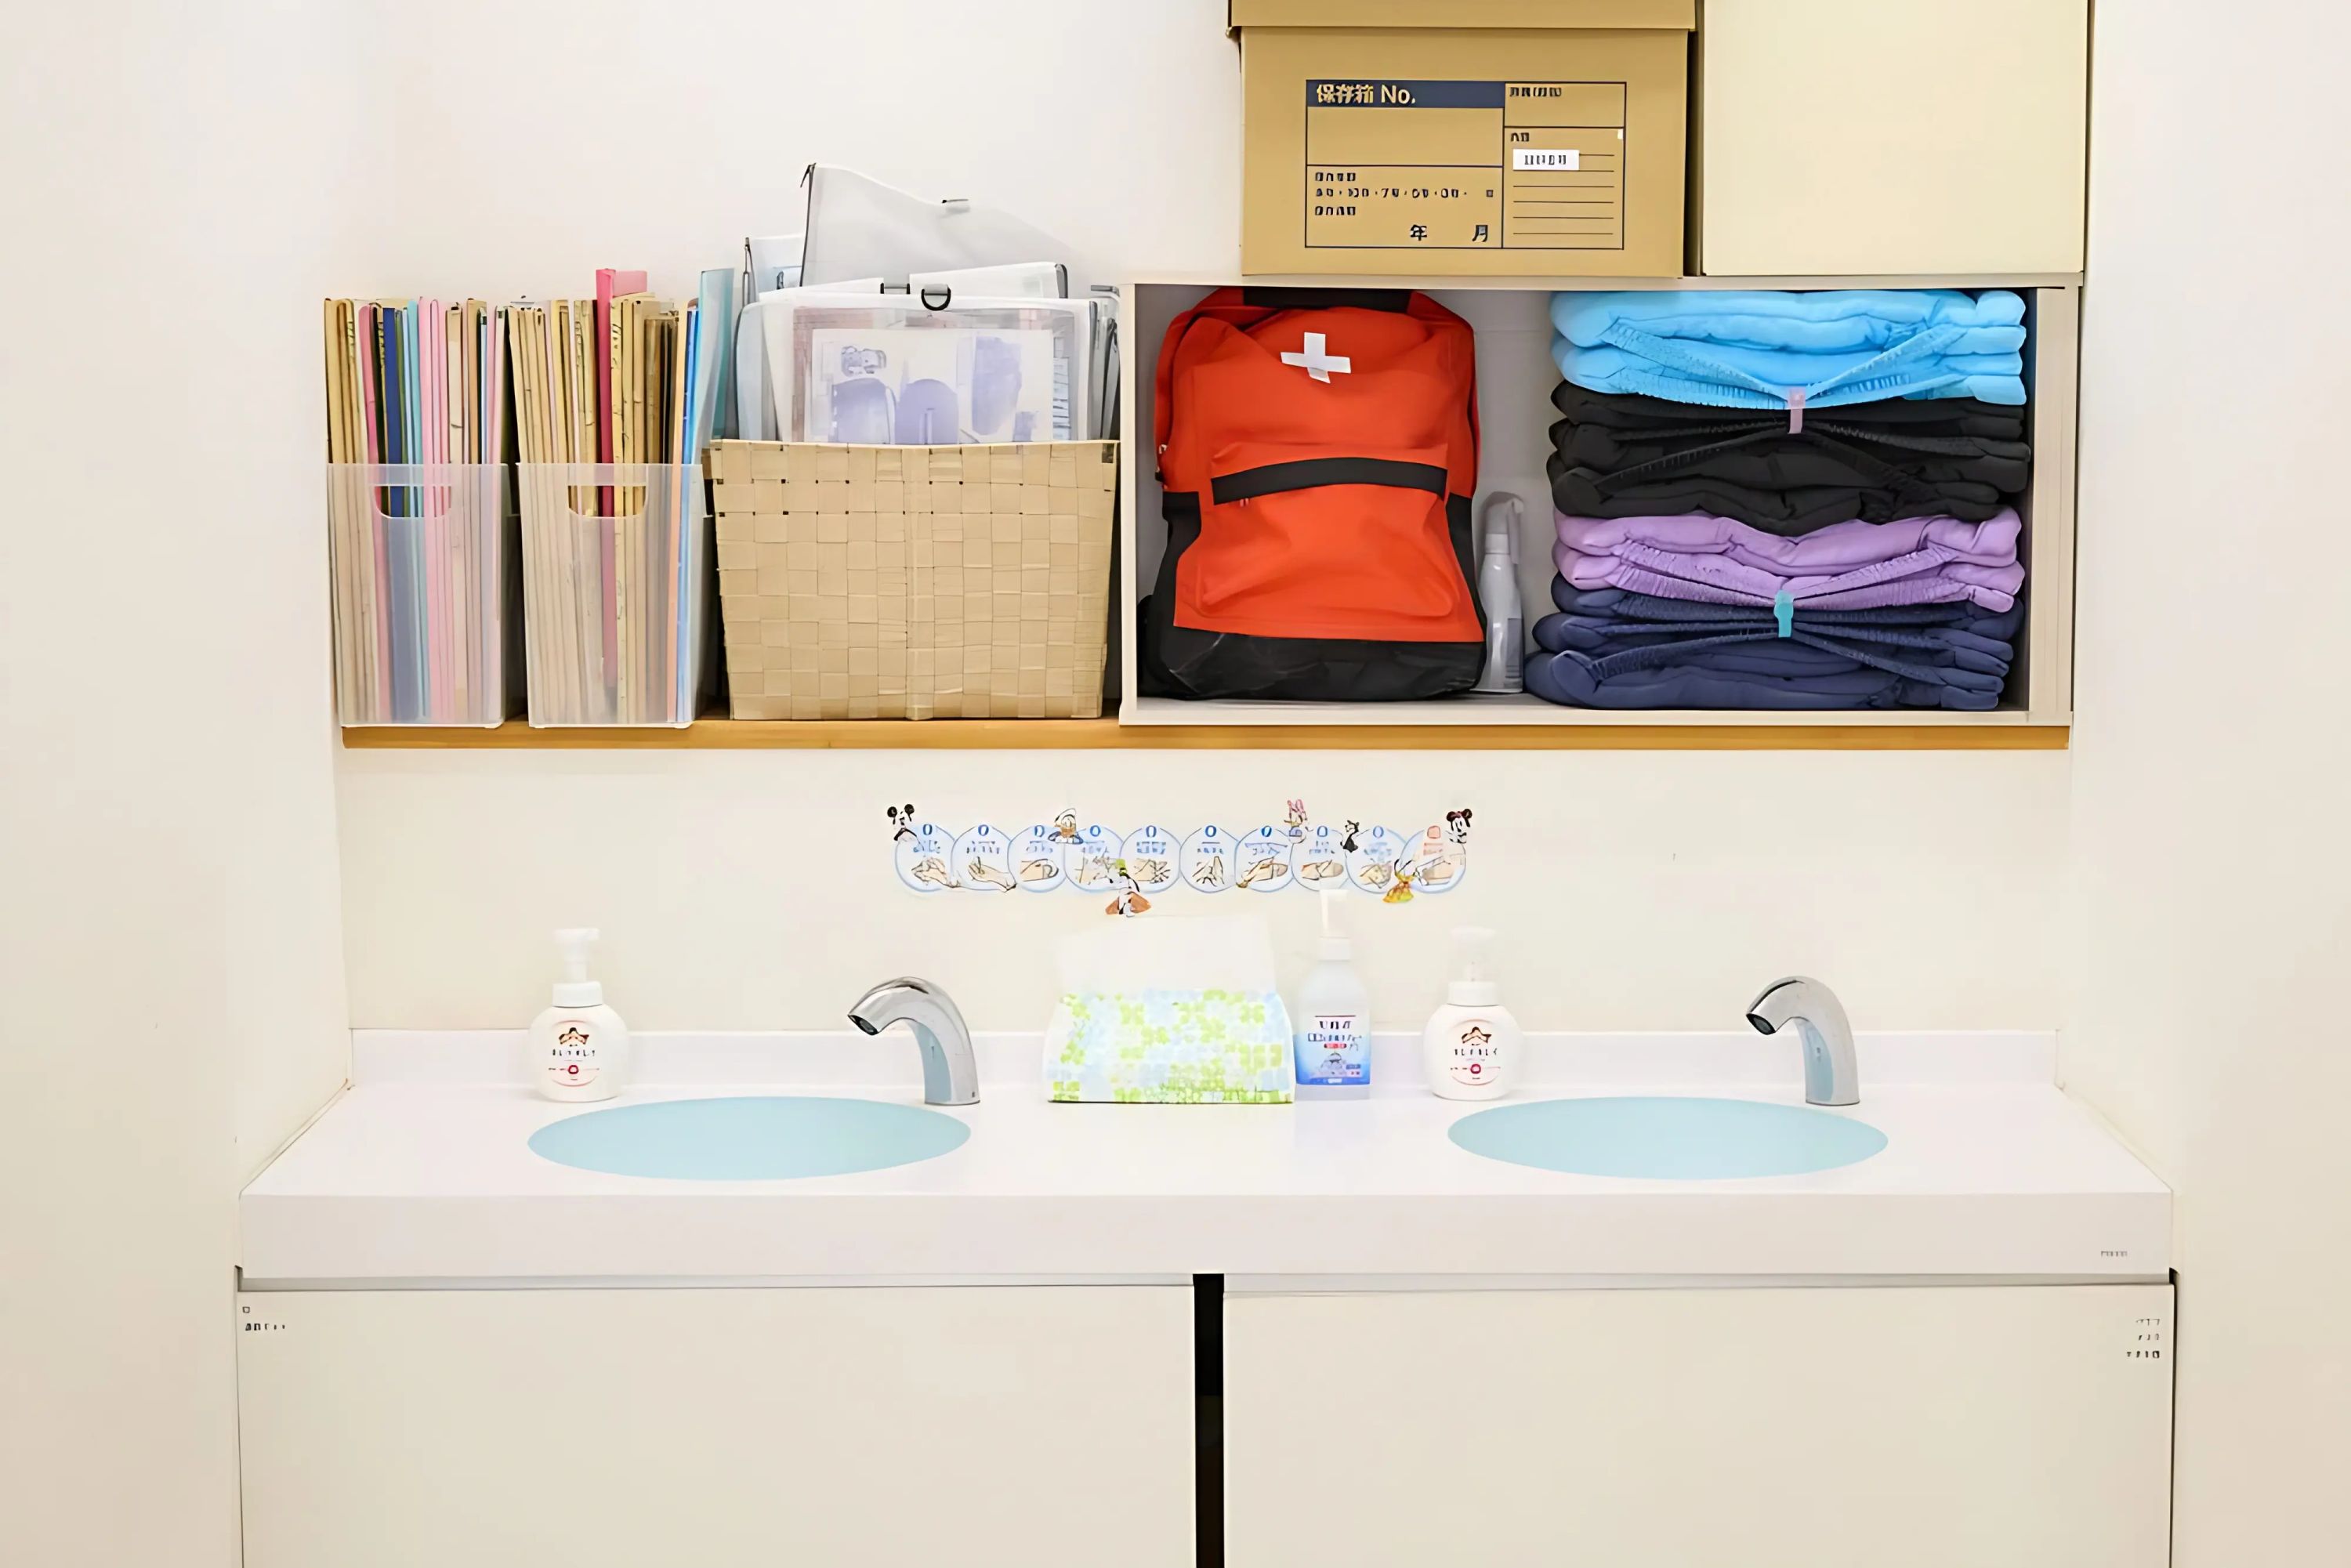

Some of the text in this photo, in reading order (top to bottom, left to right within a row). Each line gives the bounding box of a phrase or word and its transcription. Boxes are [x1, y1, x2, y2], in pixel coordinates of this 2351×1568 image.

[1381, 84, 1416, 104] No.
[1410, 224, 1488, 242] 年 月
